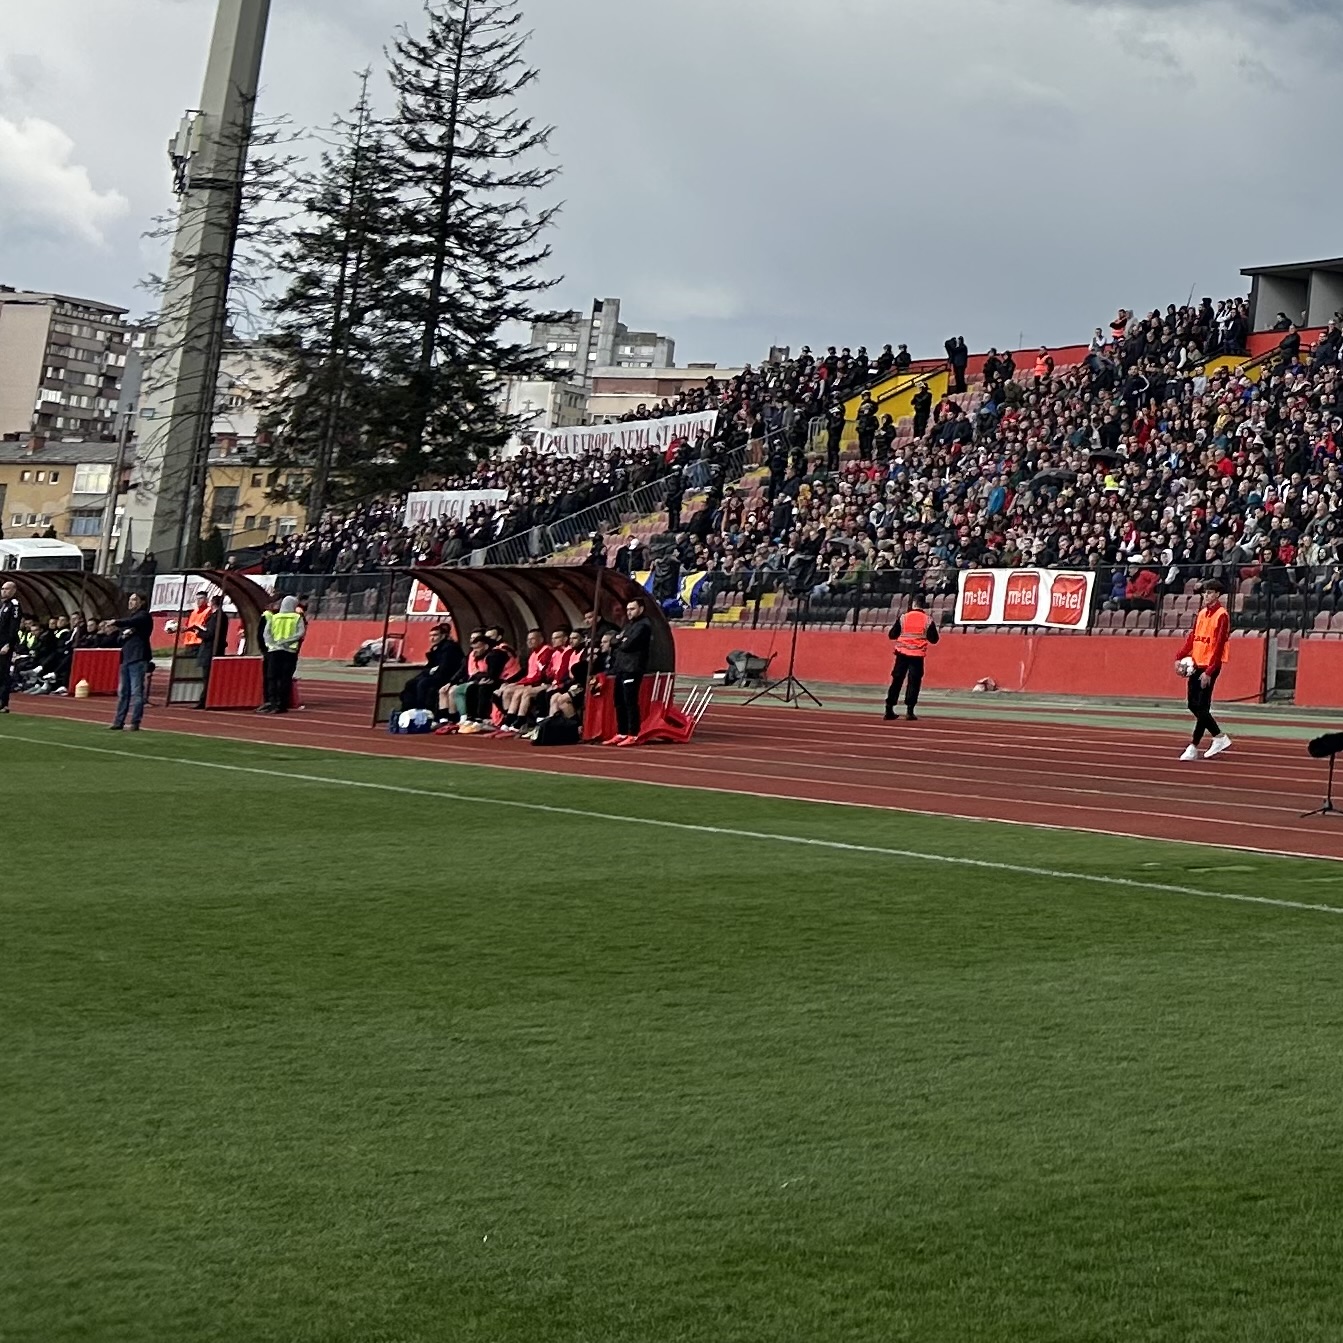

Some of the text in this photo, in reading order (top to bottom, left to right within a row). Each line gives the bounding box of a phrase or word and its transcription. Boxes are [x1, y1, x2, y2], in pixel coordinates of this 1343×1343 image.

[964, 580, 1083, 609] m:tel m:tel m:tel
